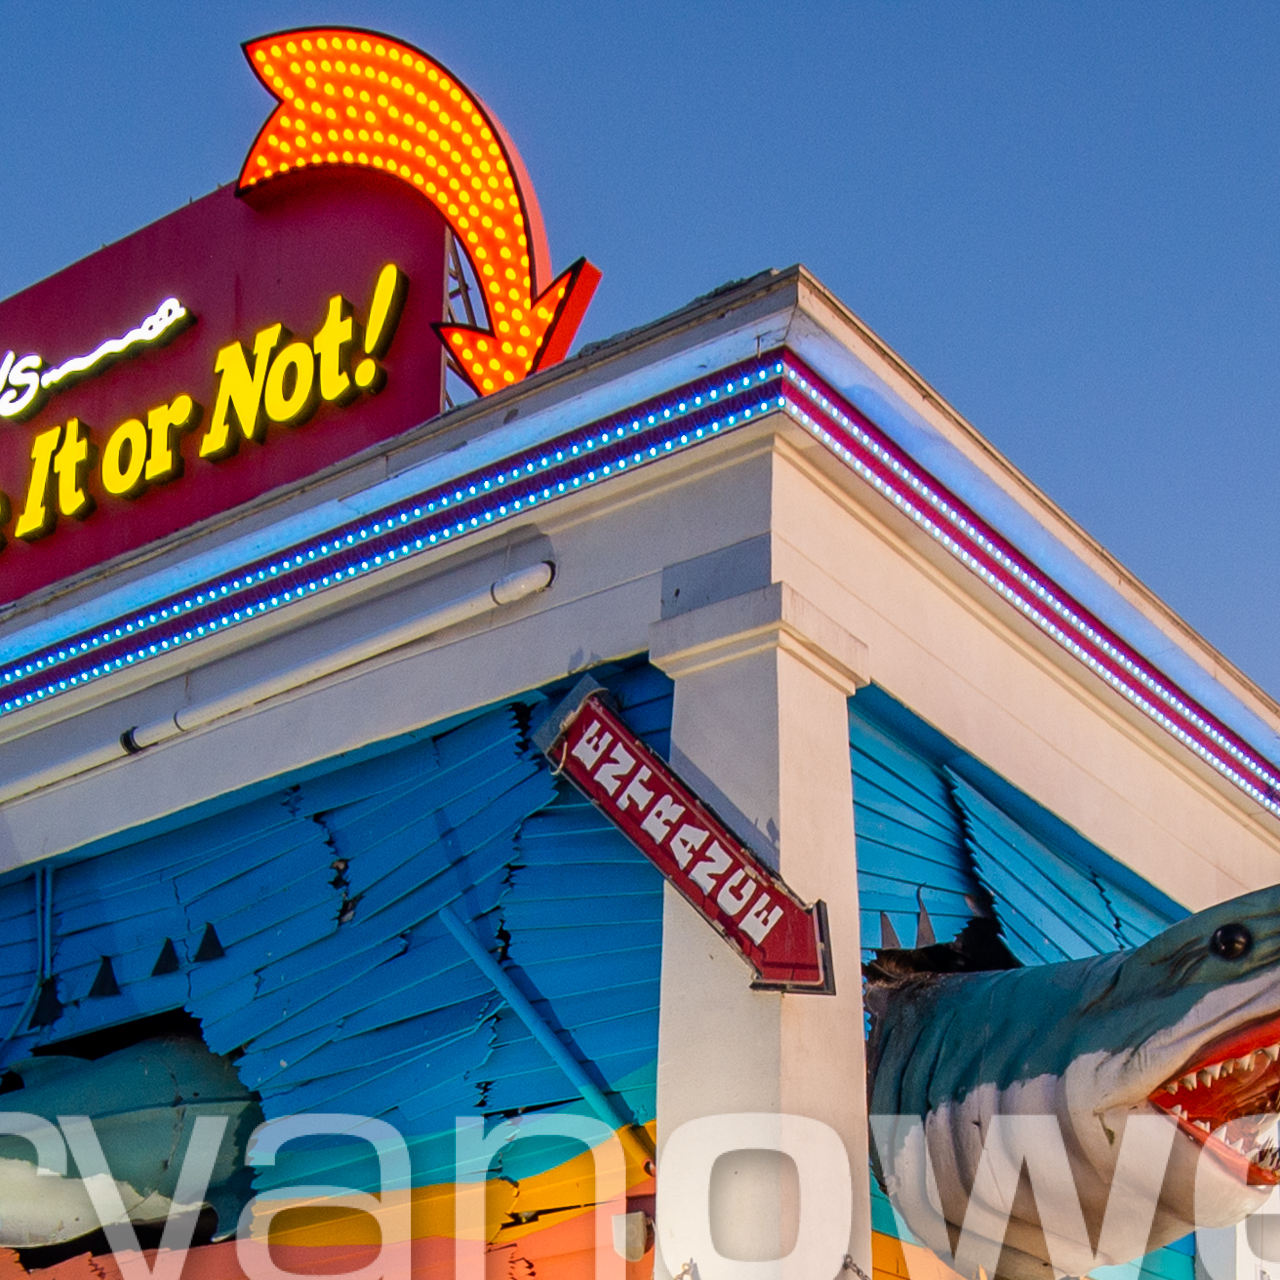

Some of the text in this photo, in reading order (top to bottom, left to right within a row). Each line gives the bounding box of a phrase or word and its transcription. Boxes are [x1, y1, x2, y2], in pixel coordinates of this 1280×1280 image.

[16, 417, 87, 538] It
[102, 394, 192, 494] or
[200, 262, 399, 458] Not!
[571, 719, 783, 946] ENTRANCE
